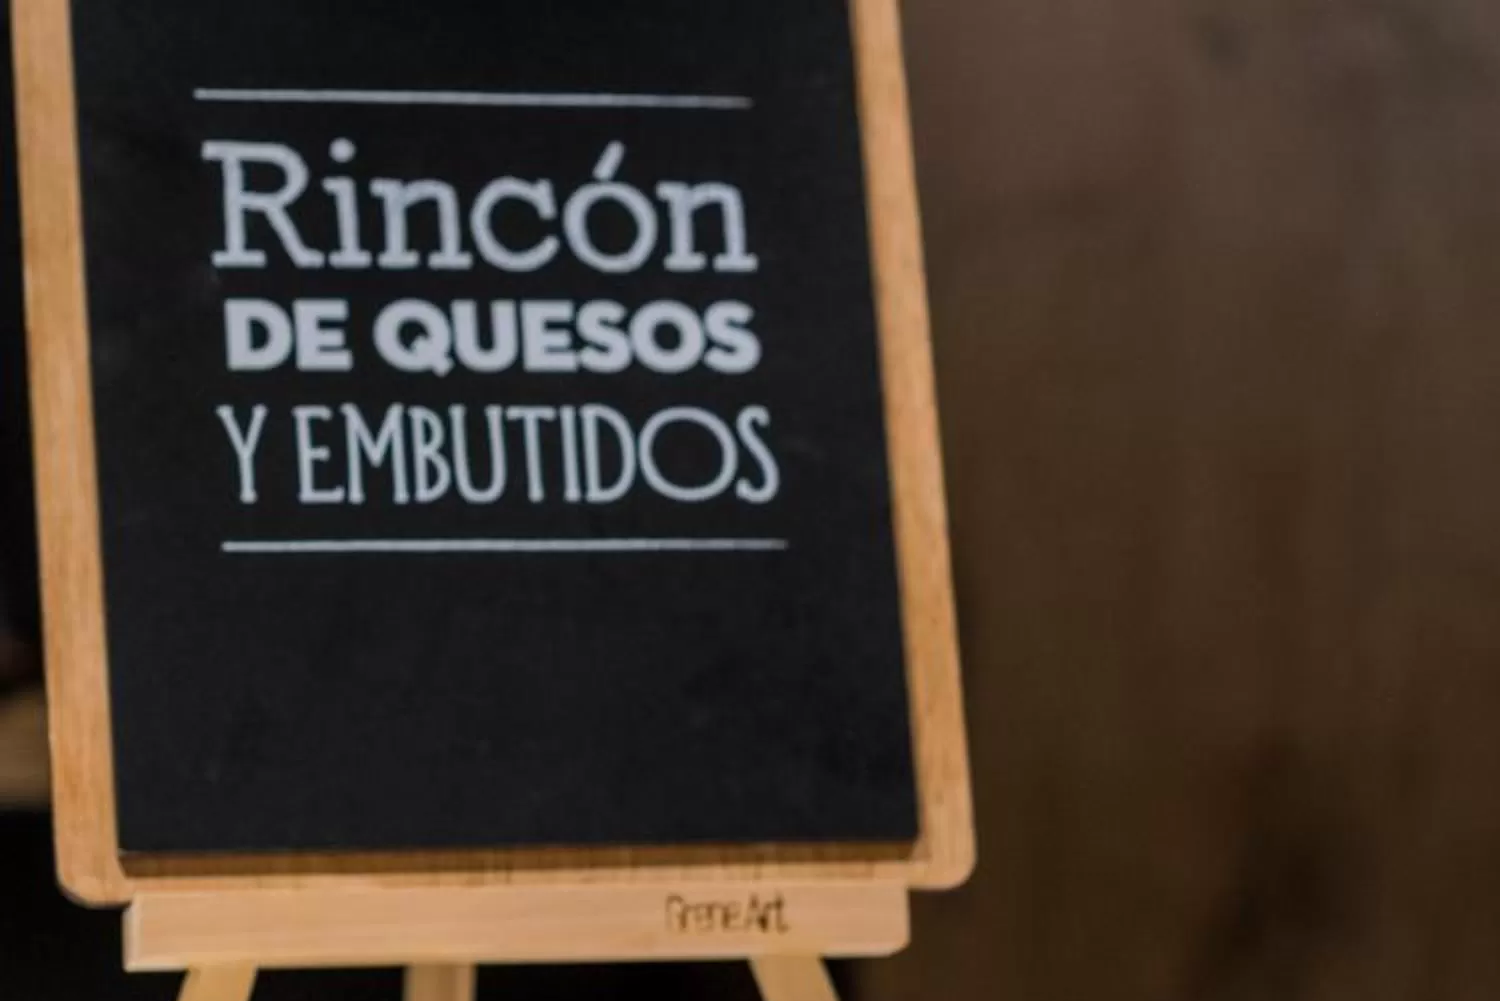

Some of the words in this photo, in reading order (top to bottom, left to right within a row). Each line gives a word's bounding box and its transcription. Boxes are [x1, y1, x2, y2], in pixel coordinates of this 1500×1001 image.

[201, 138, 759, 273] Rincón
[223, 298, 354, 372] DE
[373, 298, 762, 377] QUESOS
[215, 403, 268, 504] Y
[292, 402, 780, 505] EMBUTIDOS
